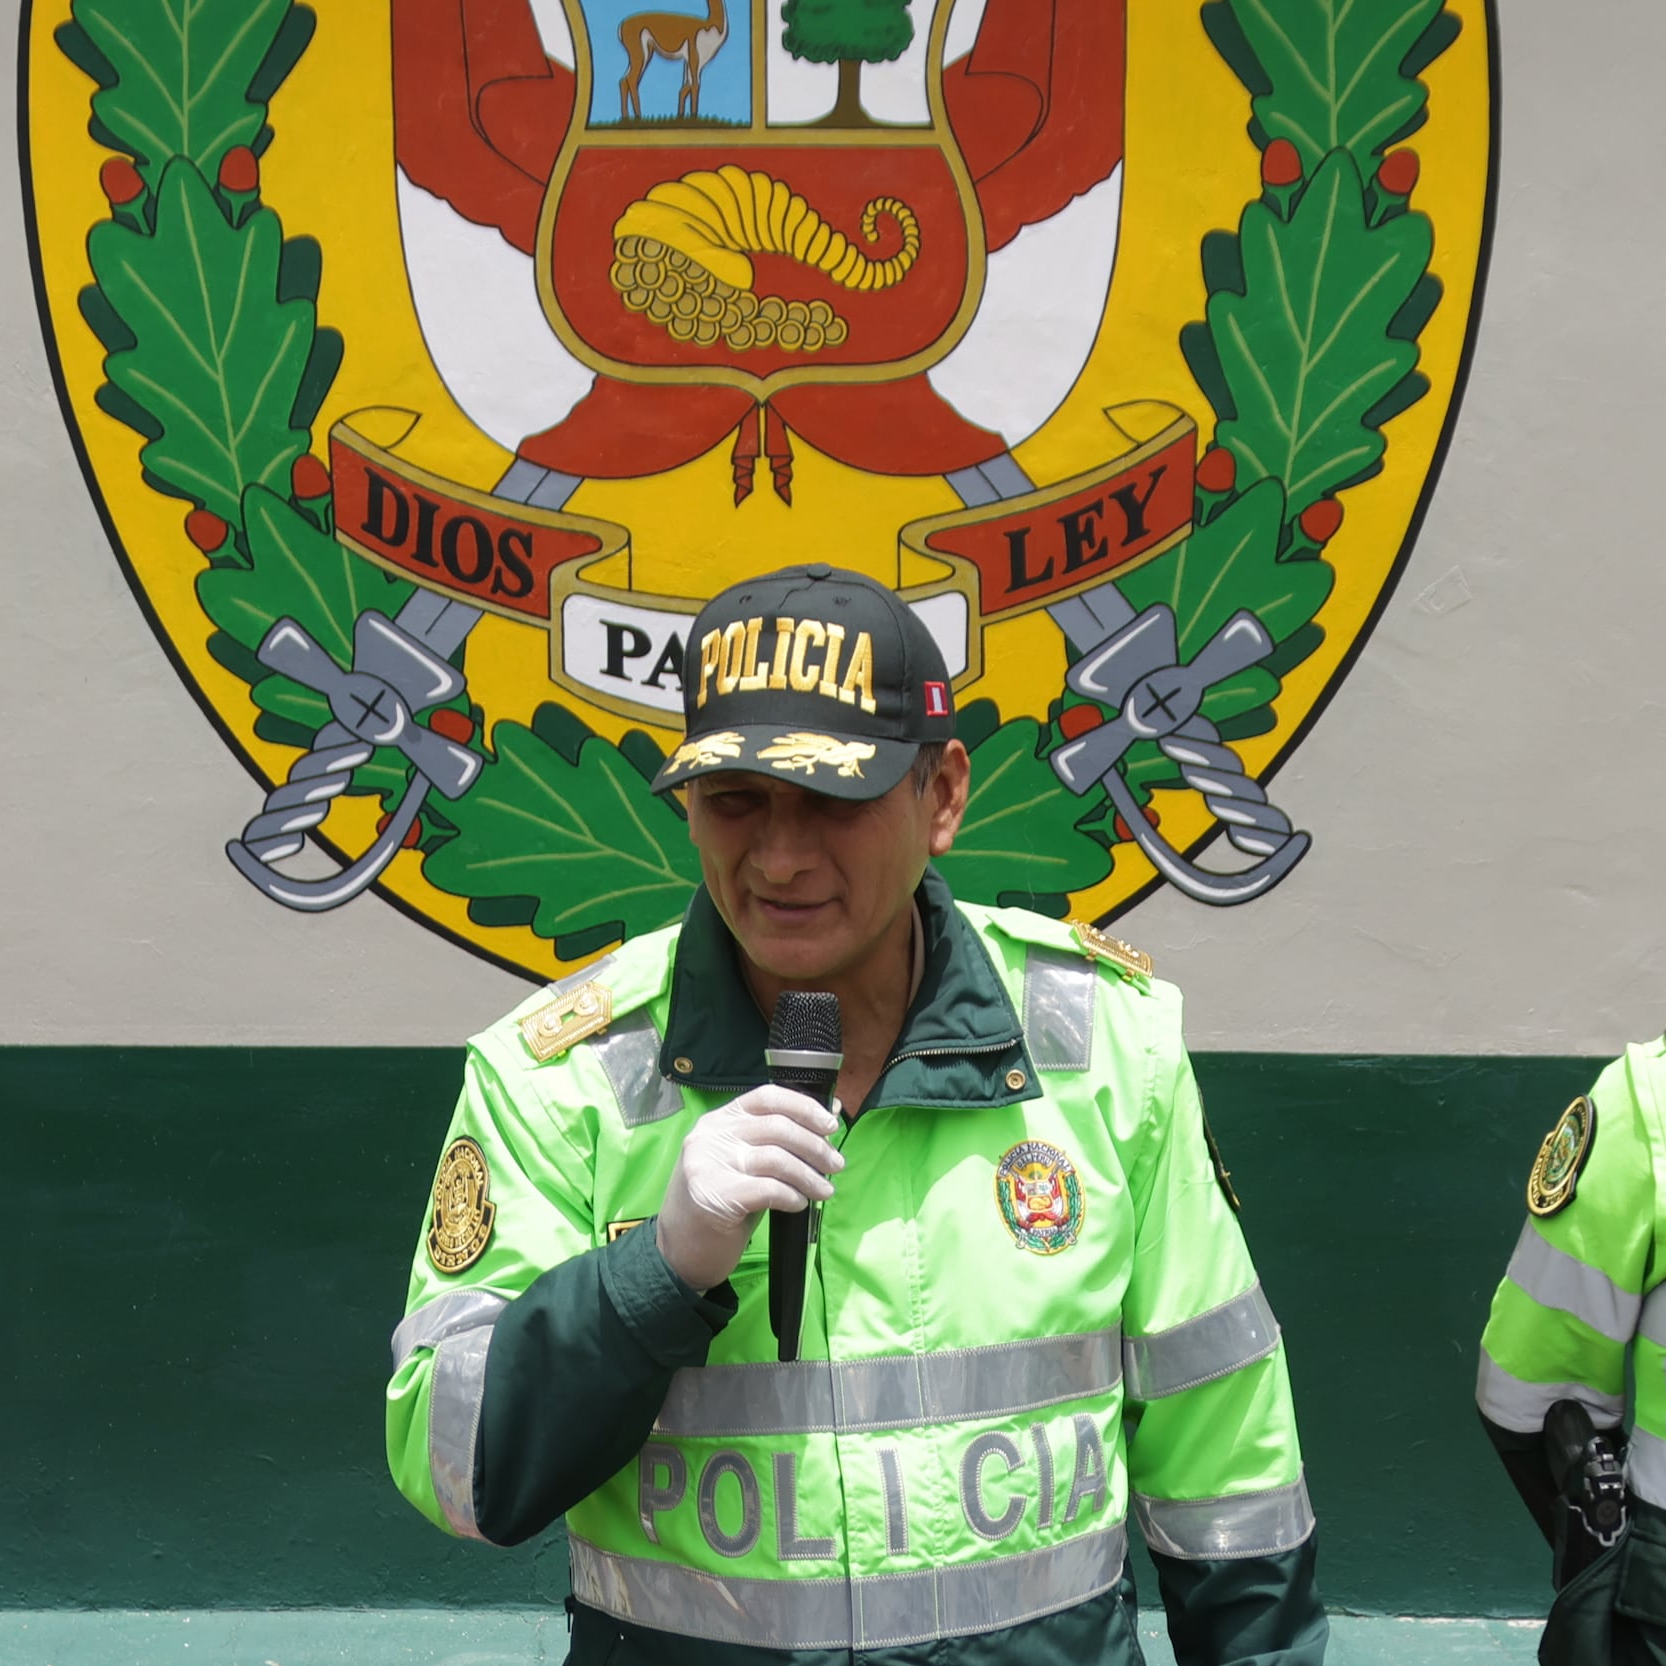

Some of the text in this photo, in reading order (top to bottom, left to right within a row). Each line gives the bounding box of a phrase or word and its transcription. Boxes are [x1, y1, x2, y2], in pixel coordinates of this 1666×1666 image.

[361, 466, 534, 598] DIOS
[1004, 464, 1168, 593] LEY
[697, 616, 876, 715] POLICIA
[638, 1412, 1108, 1561] POLICIA
